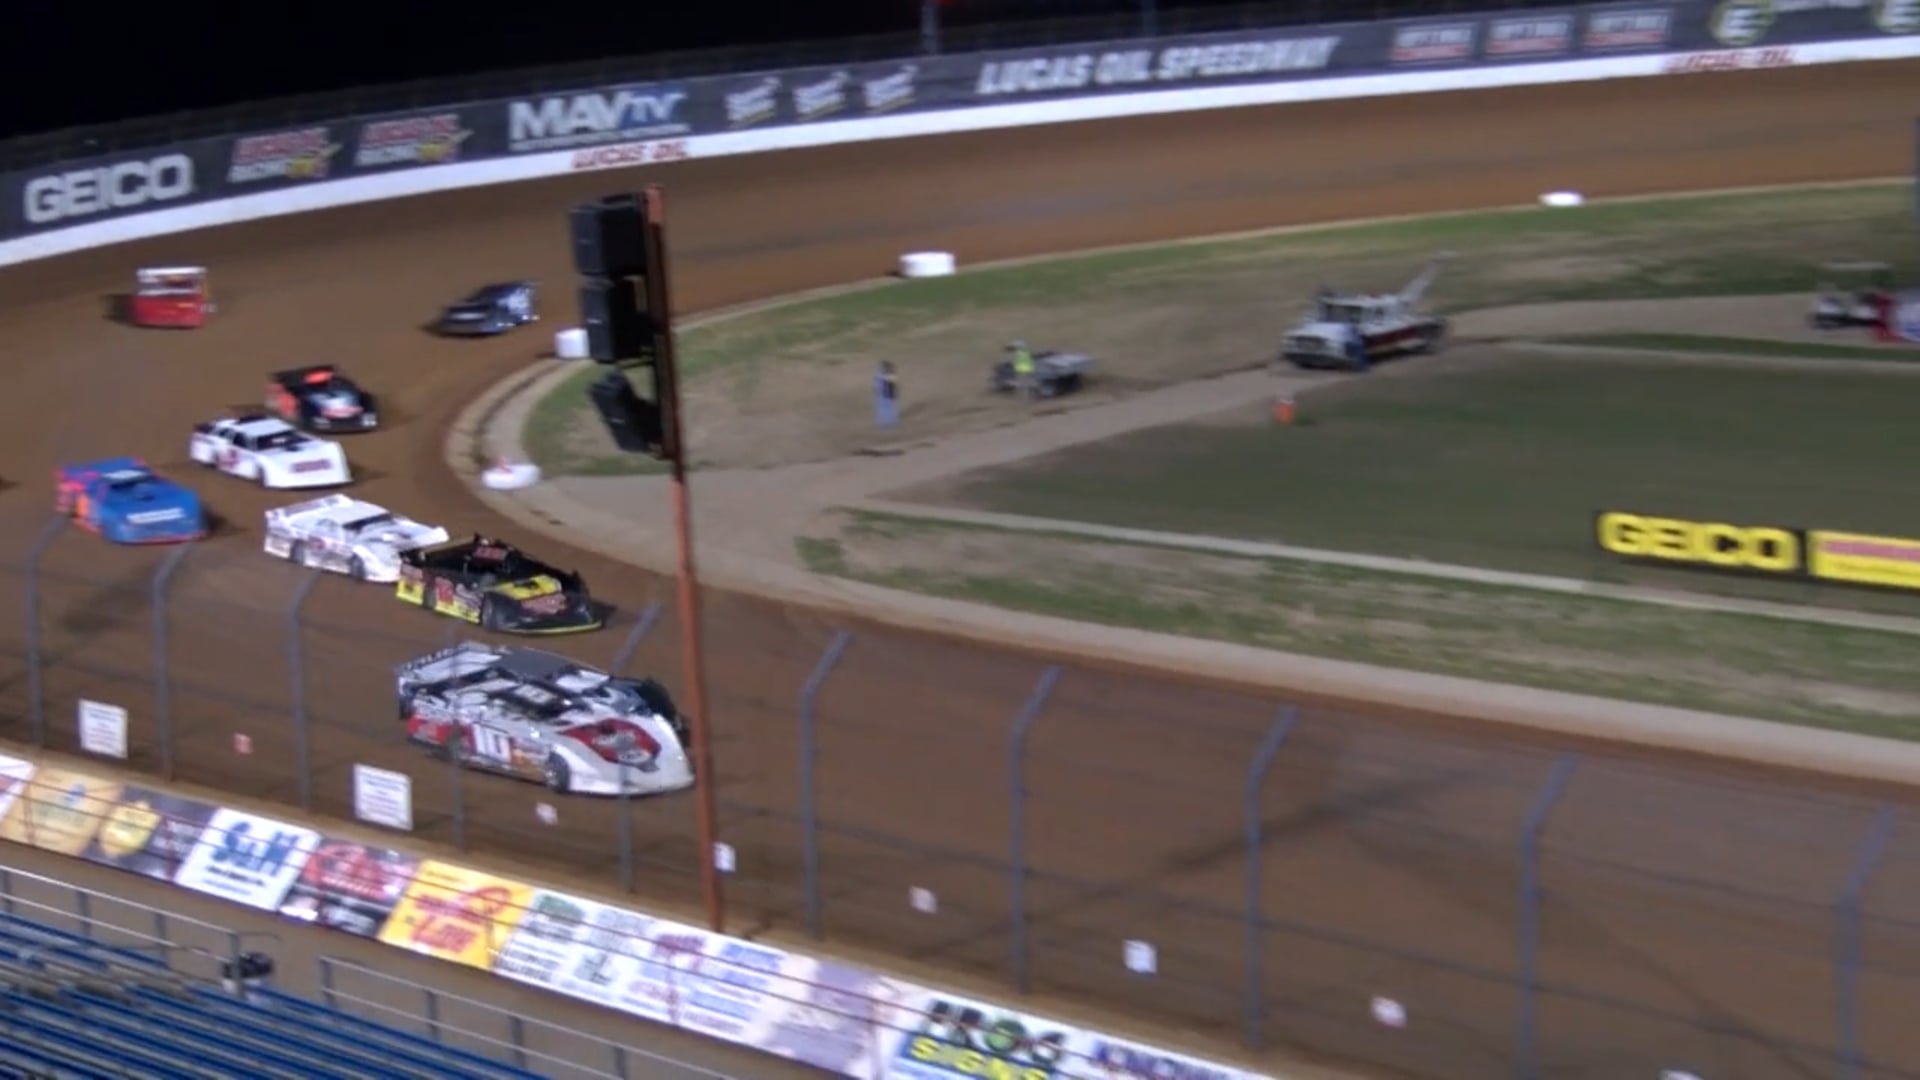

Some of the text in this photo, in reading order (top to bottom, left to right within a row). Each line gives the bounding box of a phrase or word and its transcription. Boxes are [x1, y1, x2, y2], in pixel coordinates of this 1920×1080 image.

[976, 54, 1095, 96] LUCAS
[1094, 50, 1154, 85] OIL
[1158, 36, 1340, 80] SPEEDWAY
[24, 153, 195, 224] GEICO
[1598, 511, 1798, 571] GEICO
